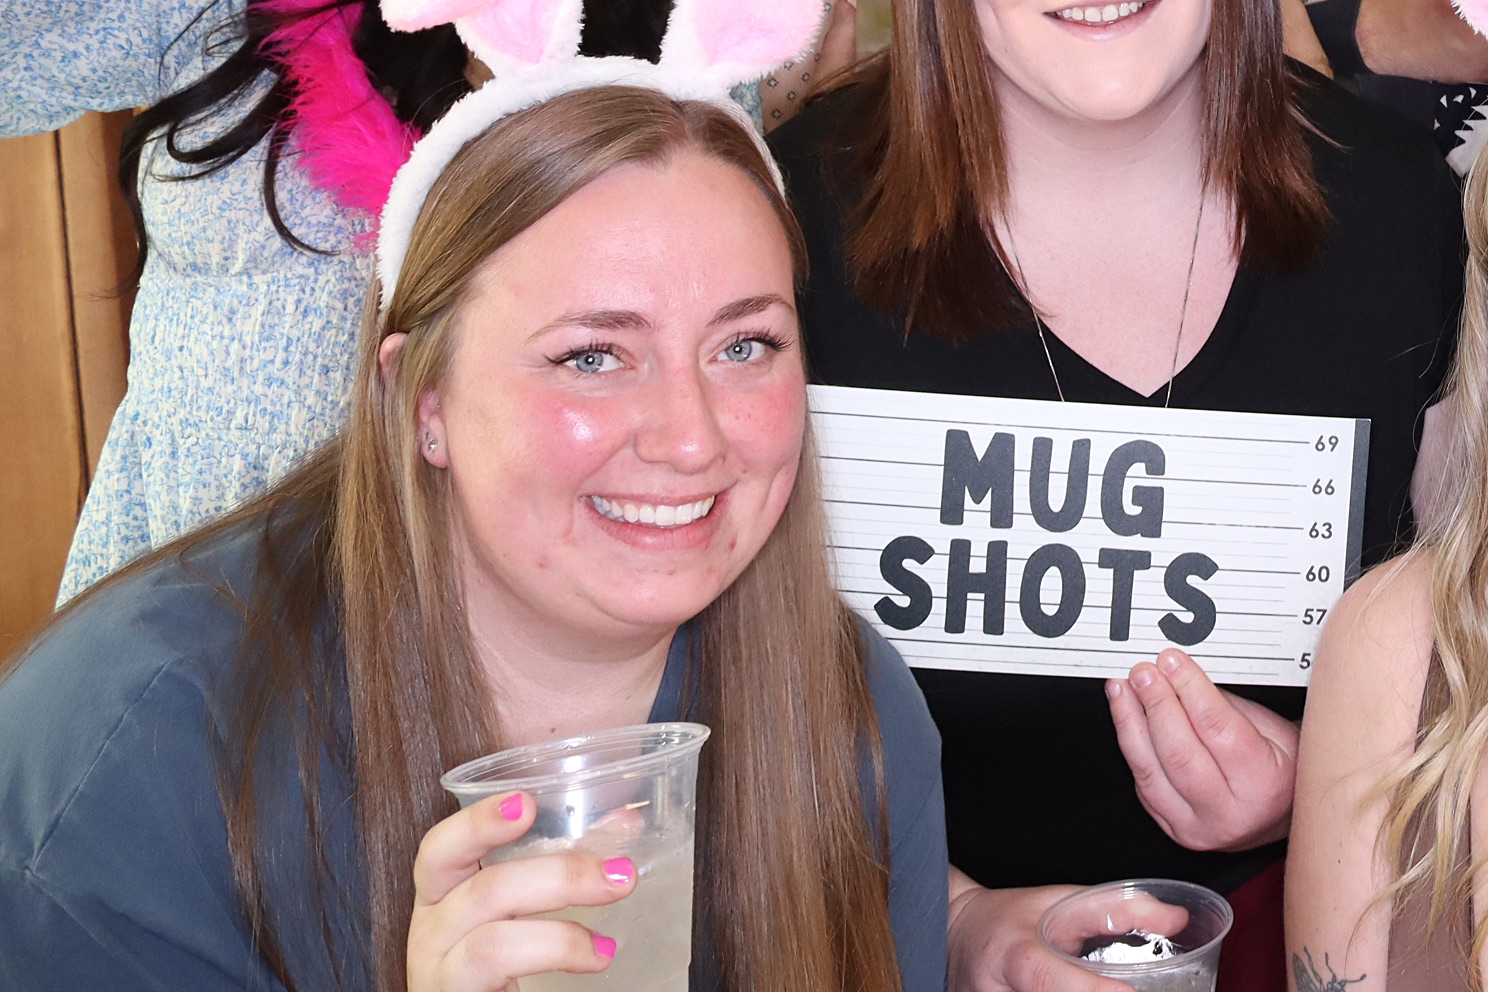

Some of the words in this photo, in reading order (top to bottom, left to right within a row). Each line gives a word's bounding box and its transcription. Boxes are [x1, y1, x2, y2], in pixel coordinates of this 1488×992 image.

[1314, 434, 1339, 452] 69
[940, 428, 1167, 538] MUG
[1311, 477, 1336, 496] 66
[1308, 521, 1333, 539] 63
[1305, 565, 1331, 583] 60
[873, 535, 1220, 647] SHOTS
[1302, 608, 1328, 626] 57
[1298, 652, 1315, 670] 5
